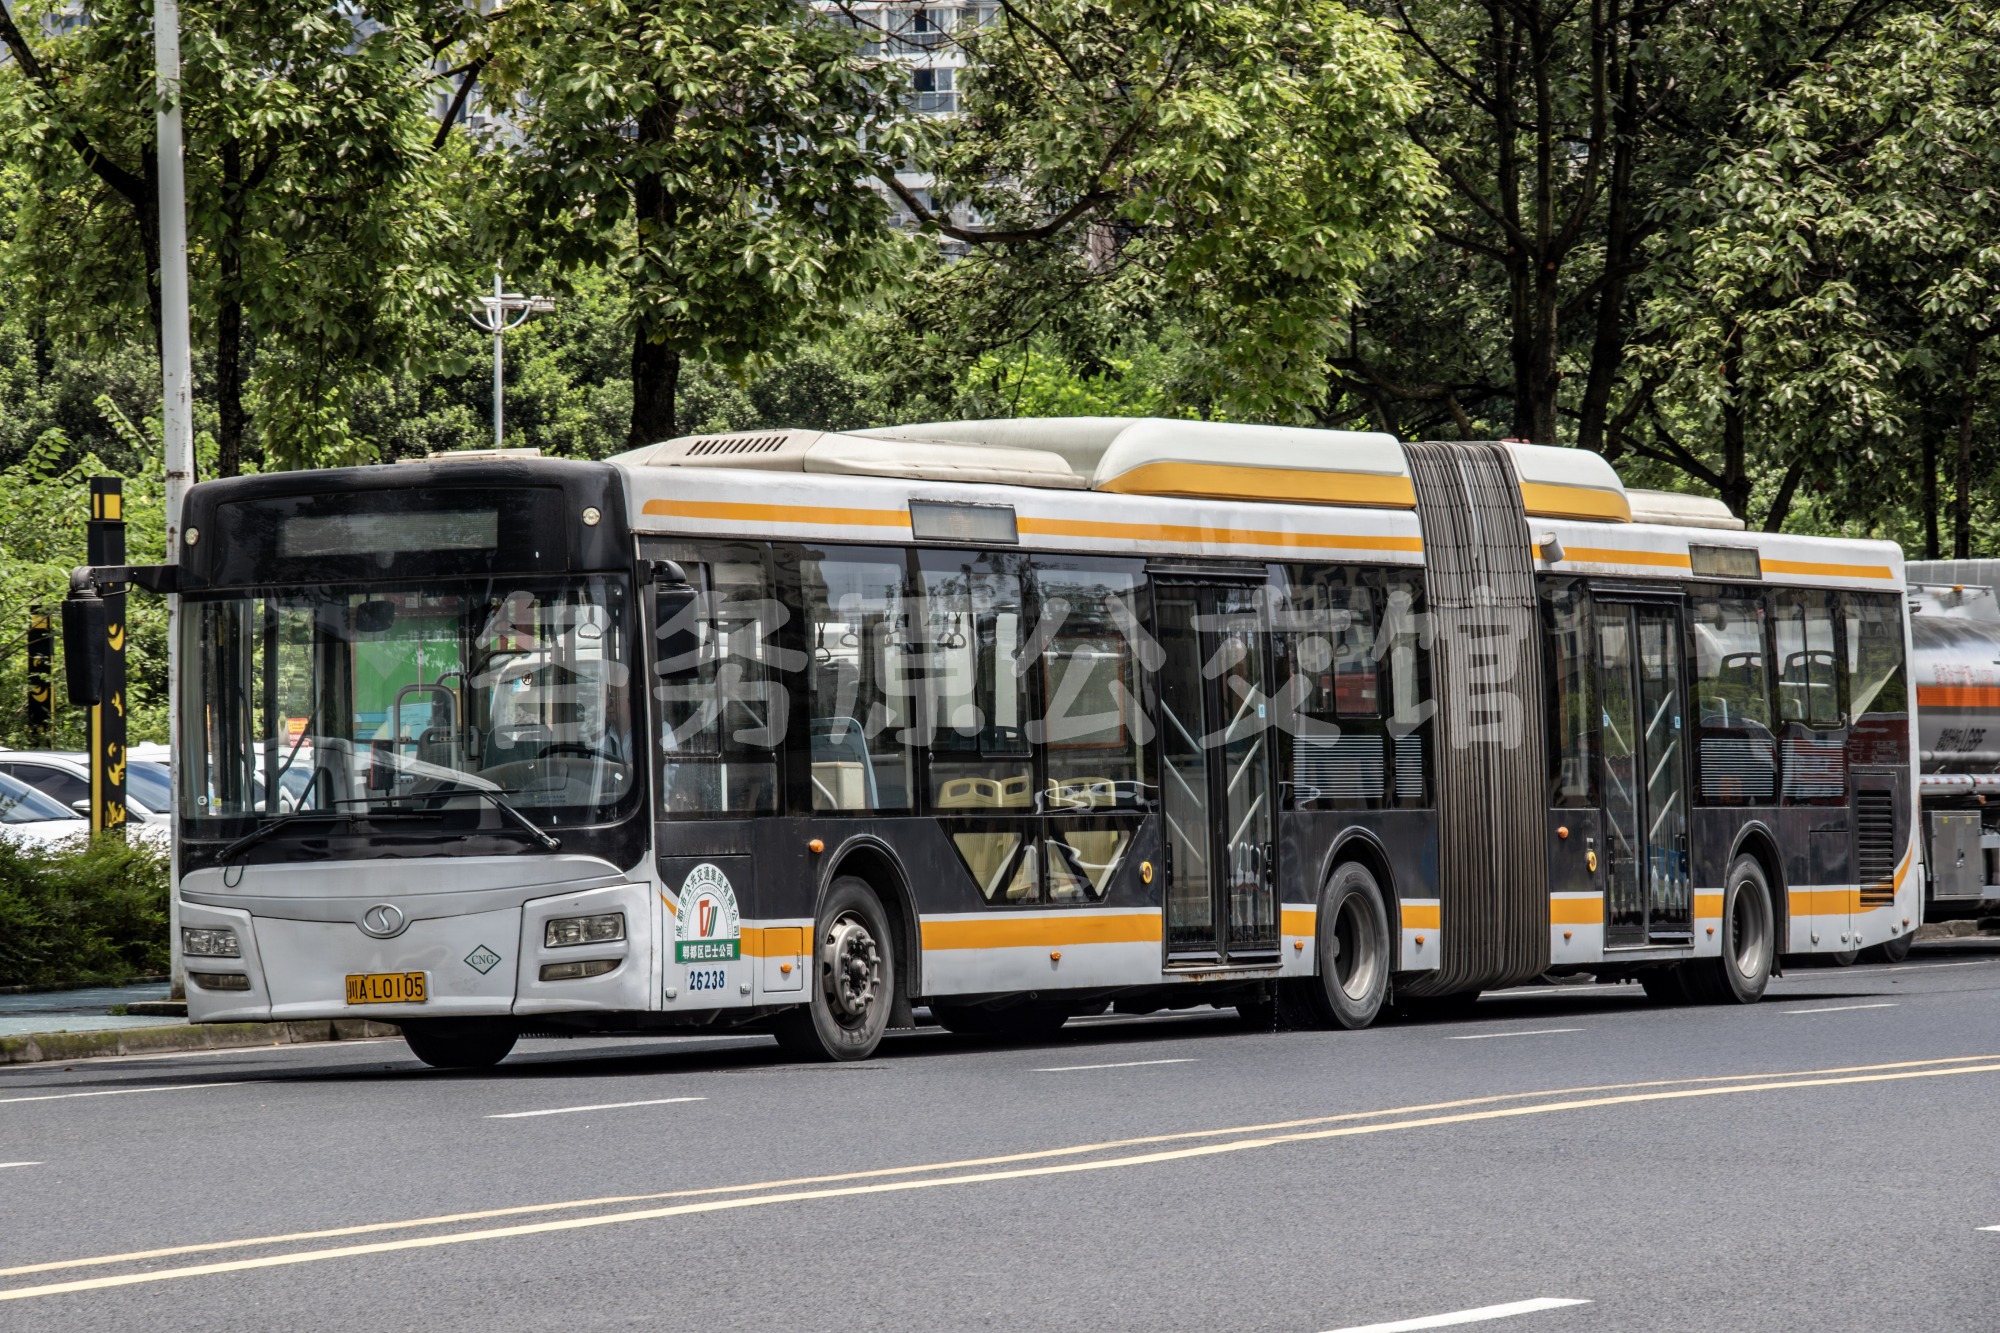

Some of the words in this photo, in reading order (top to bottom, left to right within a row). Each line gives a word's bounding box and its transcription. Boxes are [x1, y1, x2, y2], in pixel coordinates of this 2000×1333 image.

[675, 866, 740, 938] 成都市公共交通集团有限公司
[471, 954, 494, 965] CNG
[682, 944, 734, 960] 郫都区巴士公司
[689, 970, 725, 991] 26238
